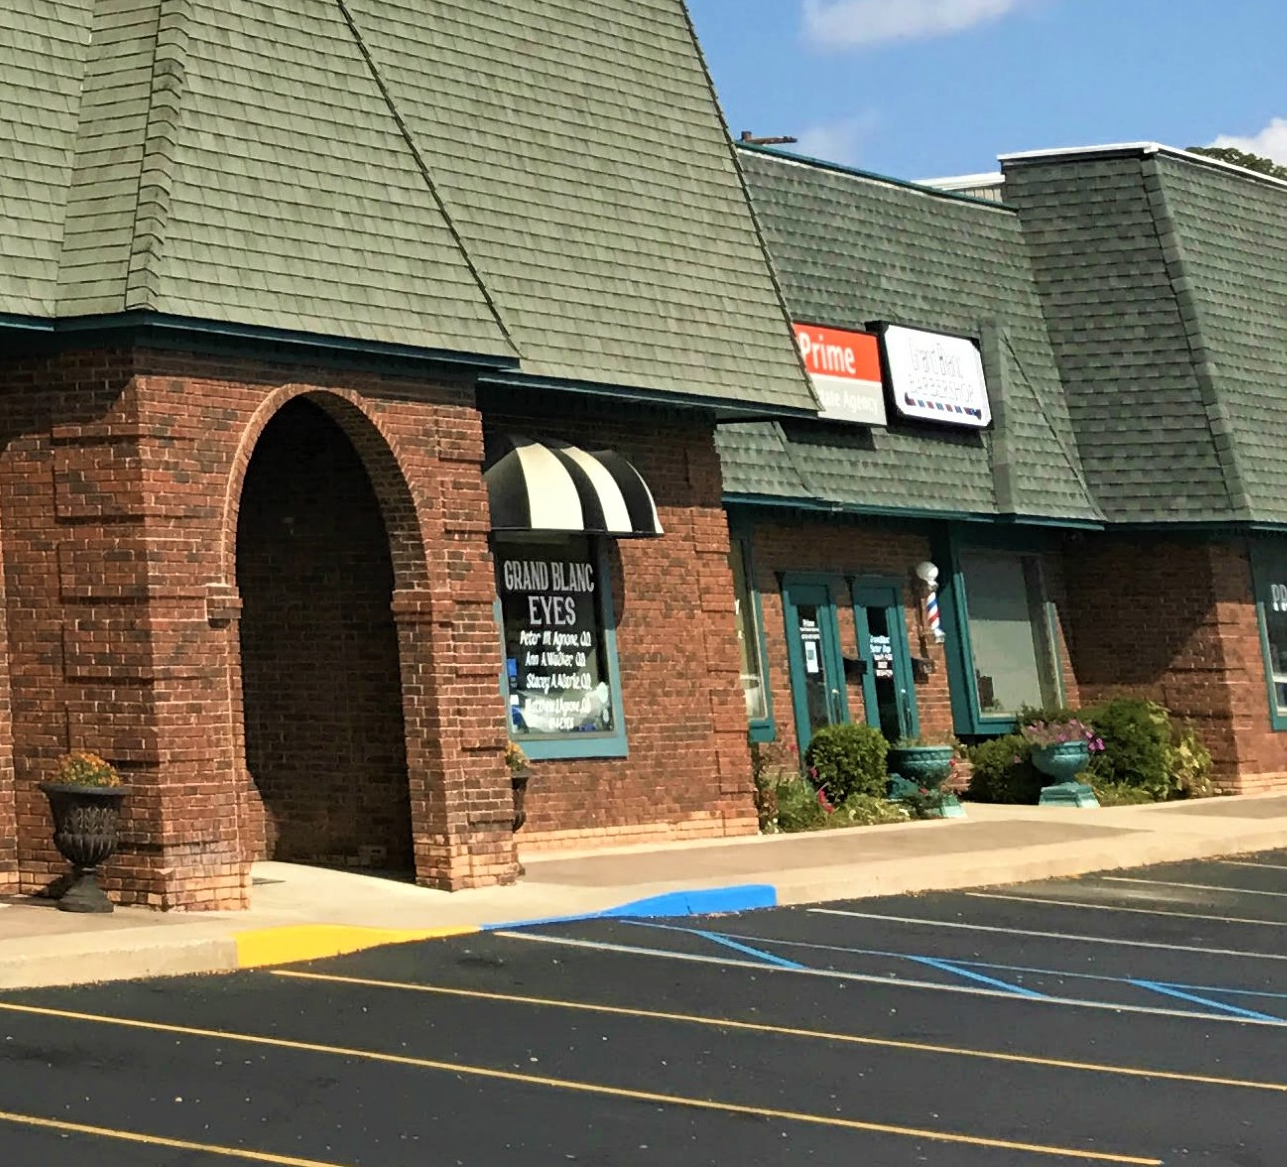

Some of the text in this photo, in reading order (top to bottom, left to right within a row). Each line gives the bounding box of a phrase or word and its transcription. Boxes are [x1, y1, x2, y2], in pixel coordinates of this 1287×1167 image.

[799, 331, 857, 375] Prime
[504, 560, 595, 593] GRAND BLANC
[528, 595, 576, 625] EYES
